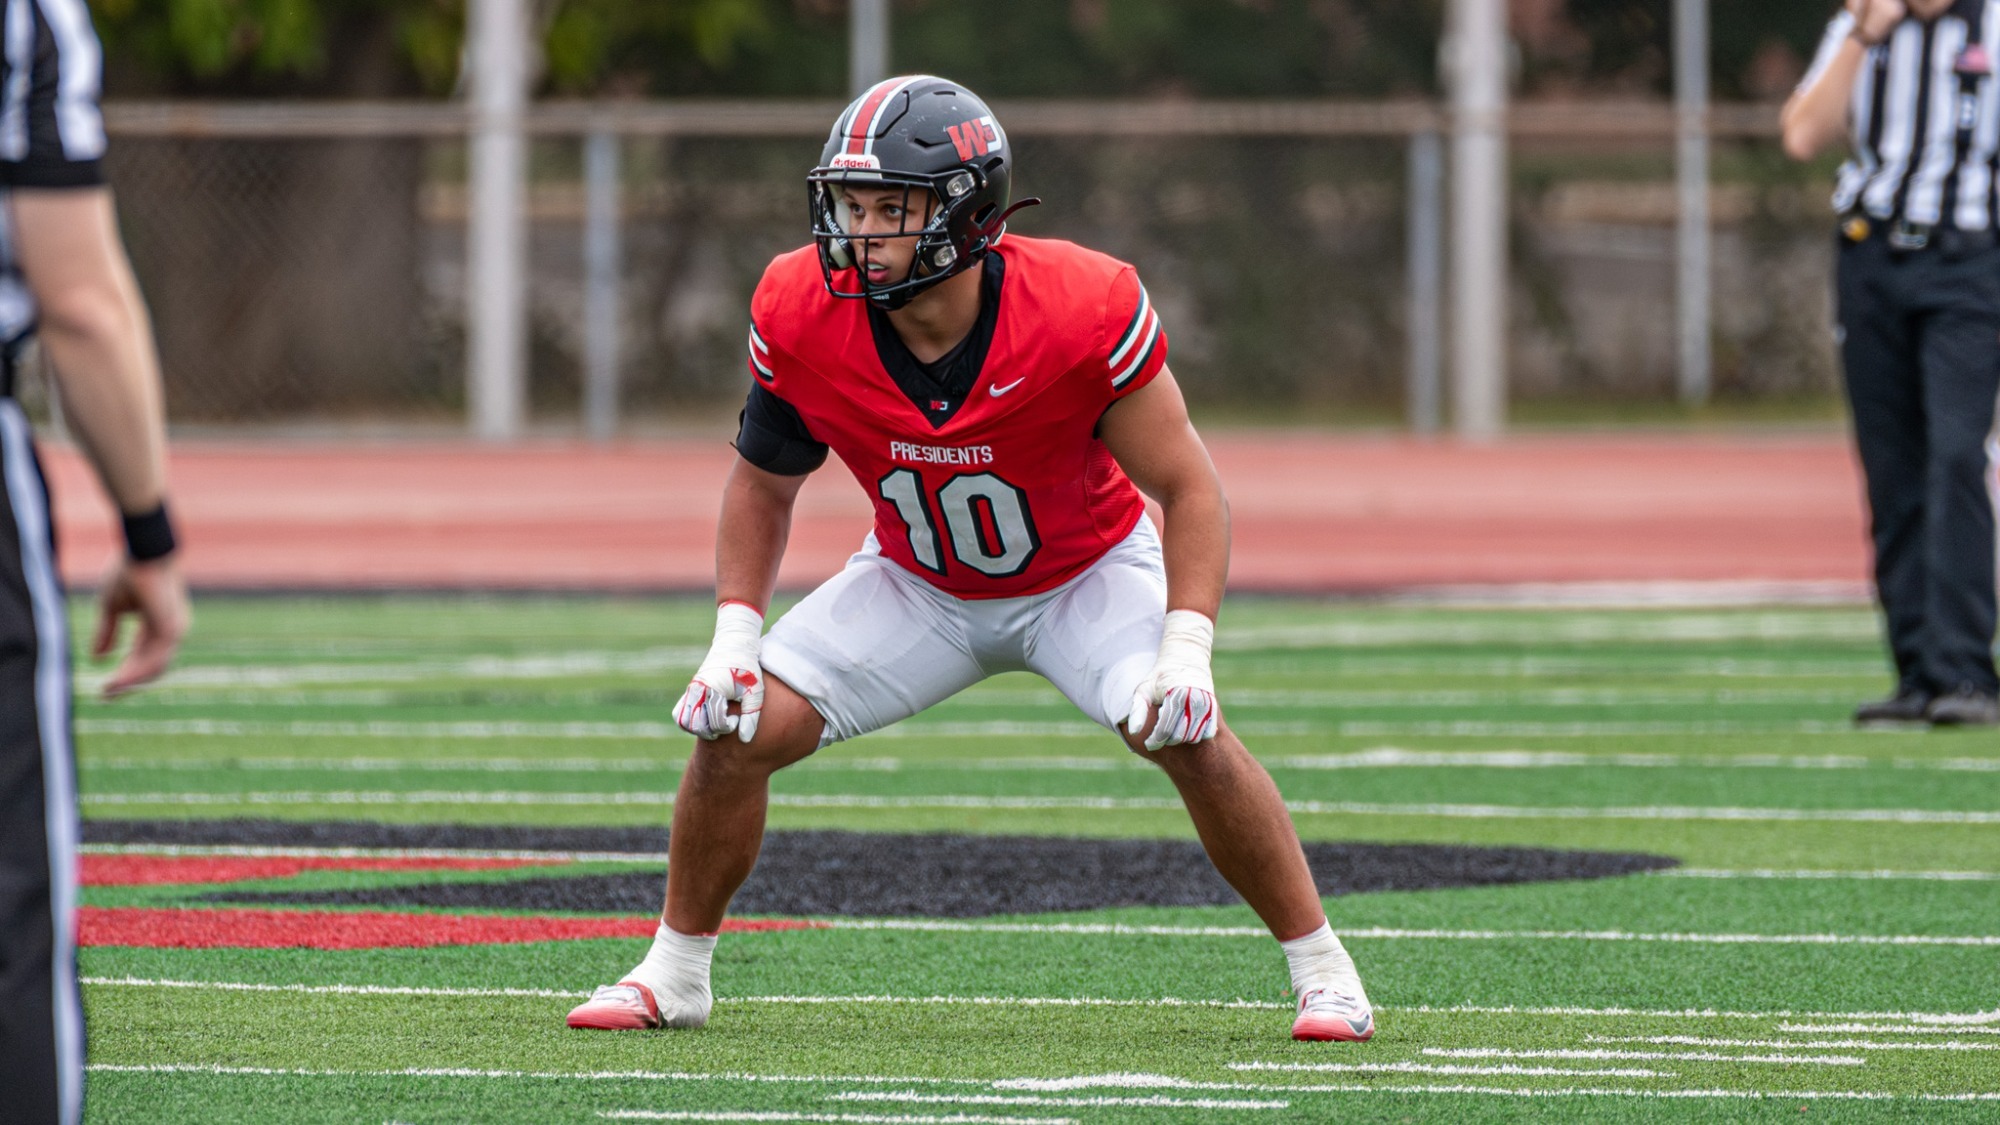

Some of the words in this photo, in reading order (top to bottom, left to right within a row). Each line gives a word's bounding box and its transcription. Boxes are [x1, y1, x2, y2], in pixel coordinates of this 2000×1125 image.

[825, 211, 848, 247] Riddll
[890, 441, 993, 464] PRESIDENTS
[878, 467, 1042, 578] 10
